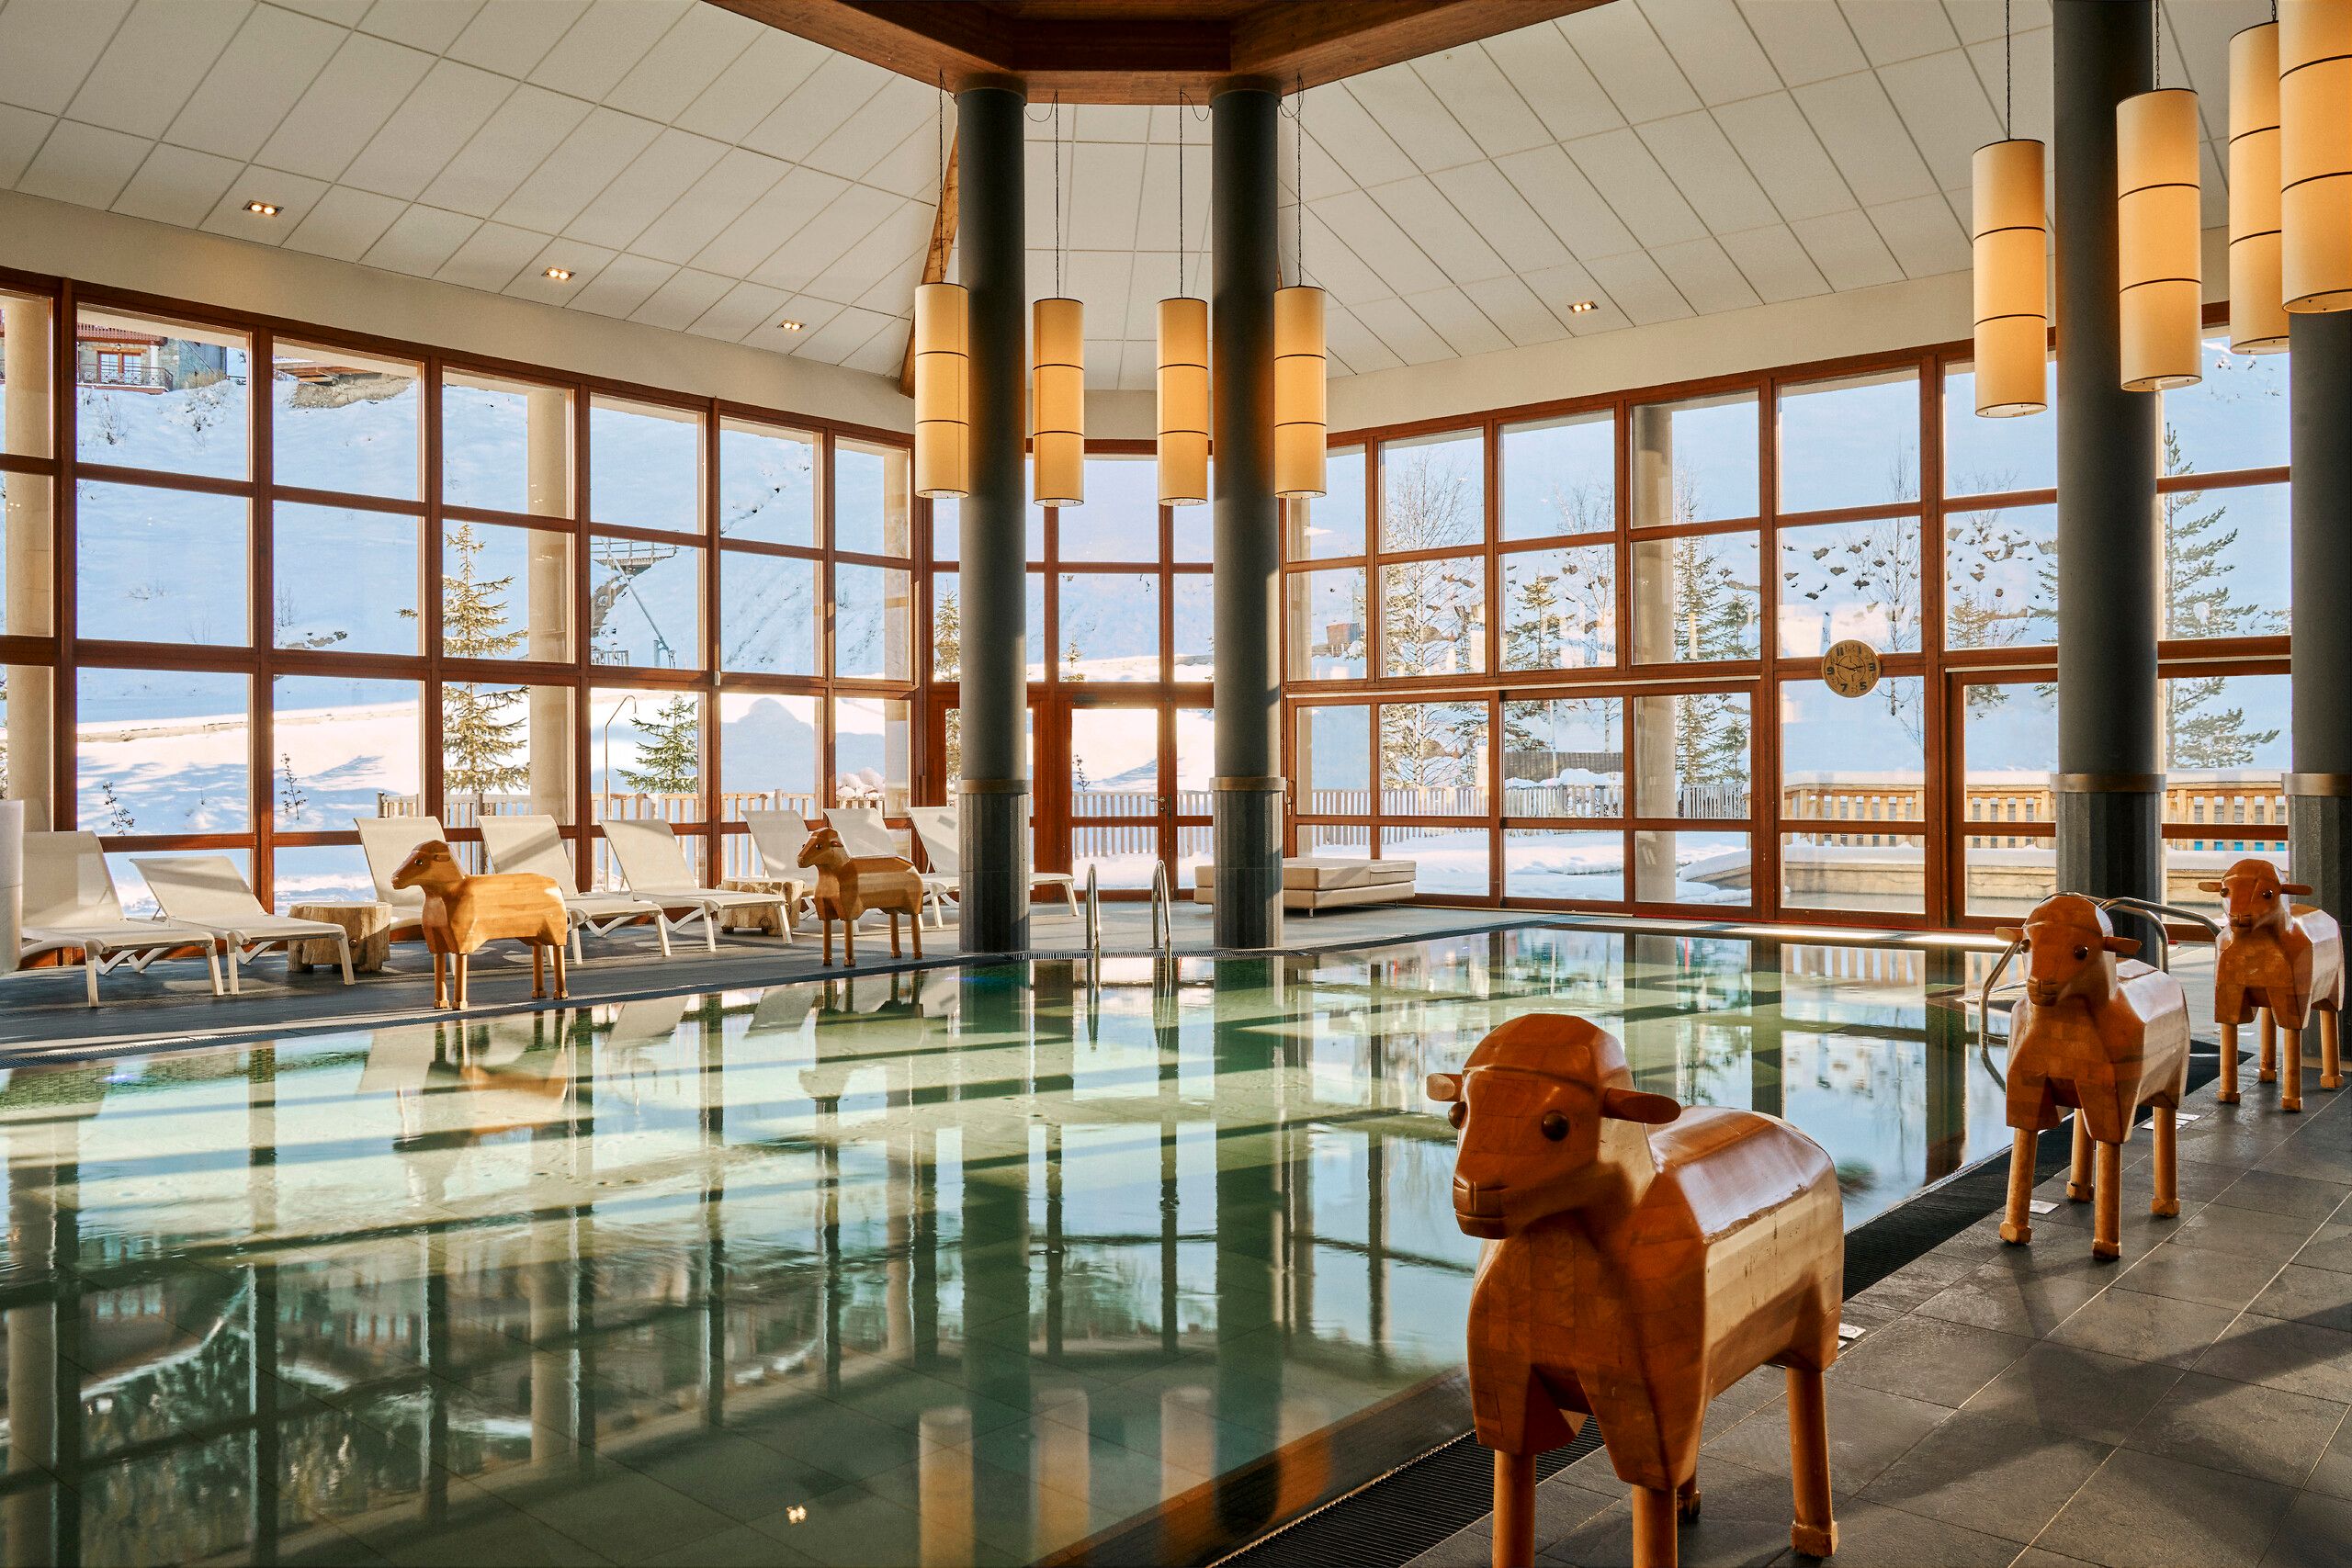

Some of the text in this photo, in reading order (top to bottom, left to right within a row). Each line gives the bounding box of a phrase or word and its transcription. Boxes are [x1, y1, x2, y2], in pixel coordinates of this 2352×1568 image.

[1826, 667, 1835, 675] 9
[1868, 662, 1876, 671] 3
[1840, 683, 1848, 693] 7
[1859, 682, 1867, 691] 5
